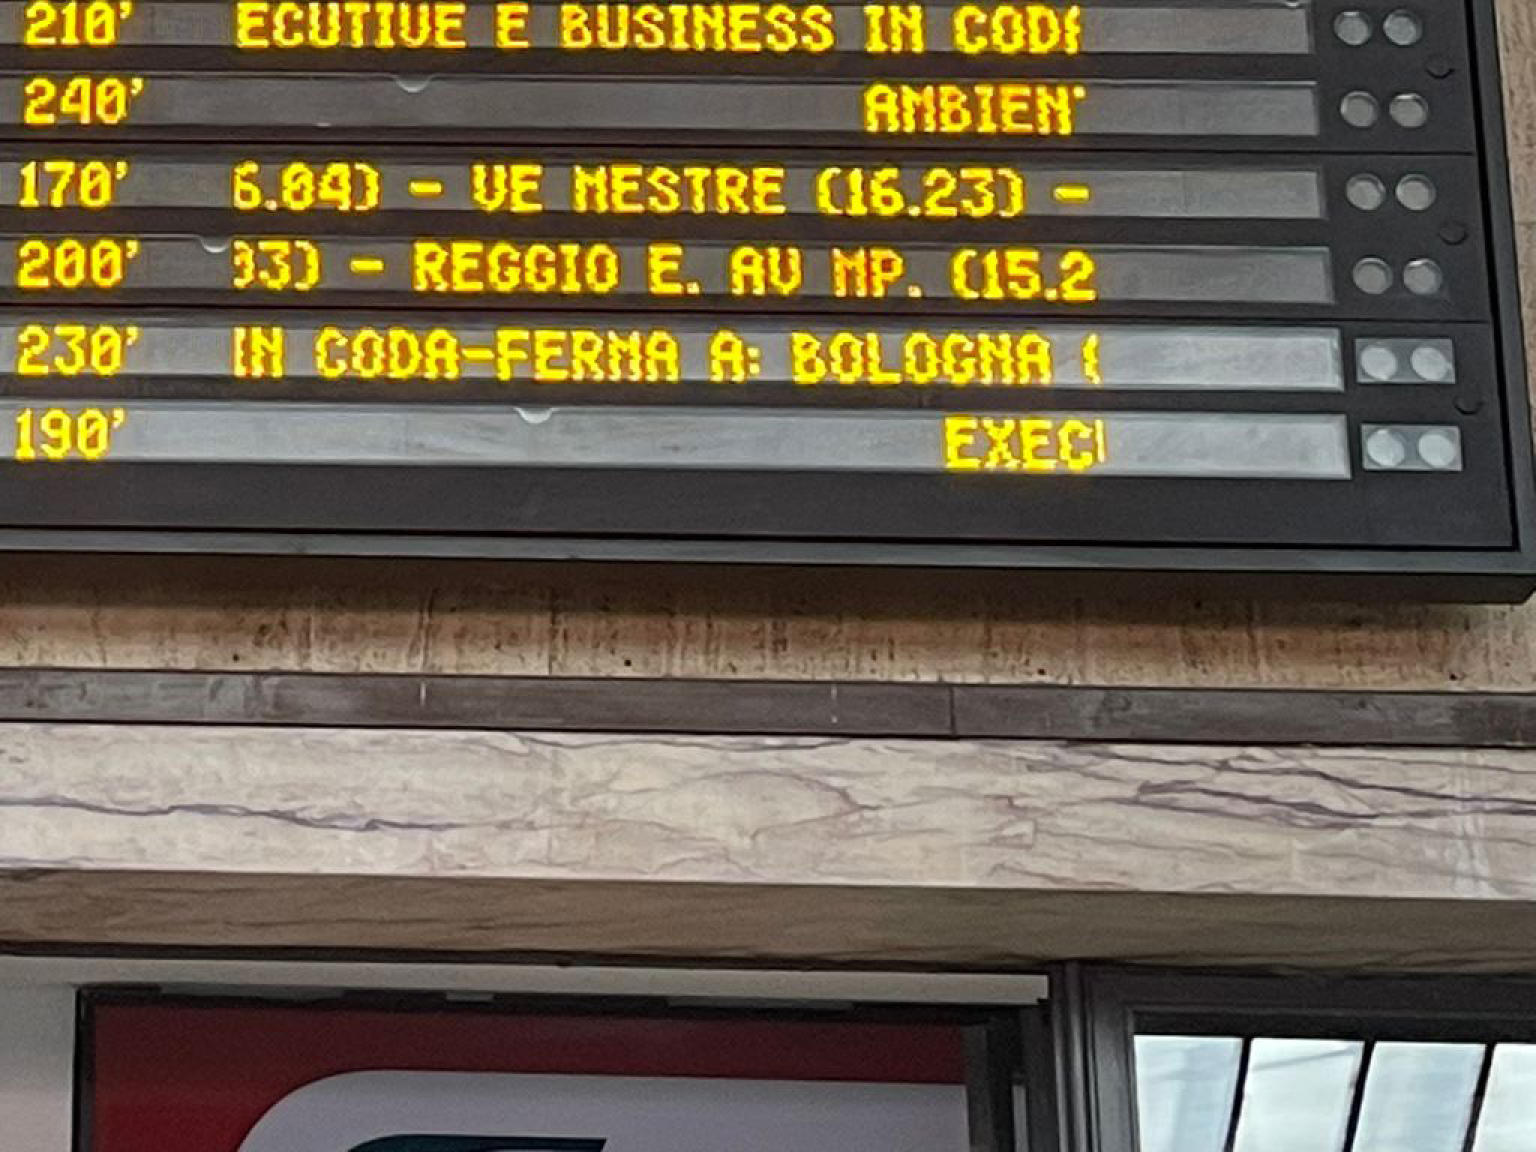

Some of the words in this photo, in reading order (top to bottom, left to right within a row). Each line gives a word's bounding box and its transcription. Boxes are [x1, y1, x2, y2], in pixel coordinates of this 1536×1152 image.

[236, 2, 466, 49] ECUTIVE
[496, 3, 530, 49] E
[560, 4, 834, 52] BUSINESS
[863, 5, 925, 53] IN
[863, 84, 1086, 135] AMBIEN
[473, 164, 543, 212] VE
[574, 165, 785, 214] MESTRE
[817, 167, 1024, 217] (16.23)
[413, 242, 619, 293] REGGIO
[648, 244, 700, 294] E.
[731, 246, 802, 295] AV
[833, 248, 921, 298] MP.
[953, 249, 1096, 301] (15.2
[314, 326, 679, 382] CODA-FERMA
[710, 330, 760, 382] A:
[791, 332, 1053, 385] BOLOGNA
